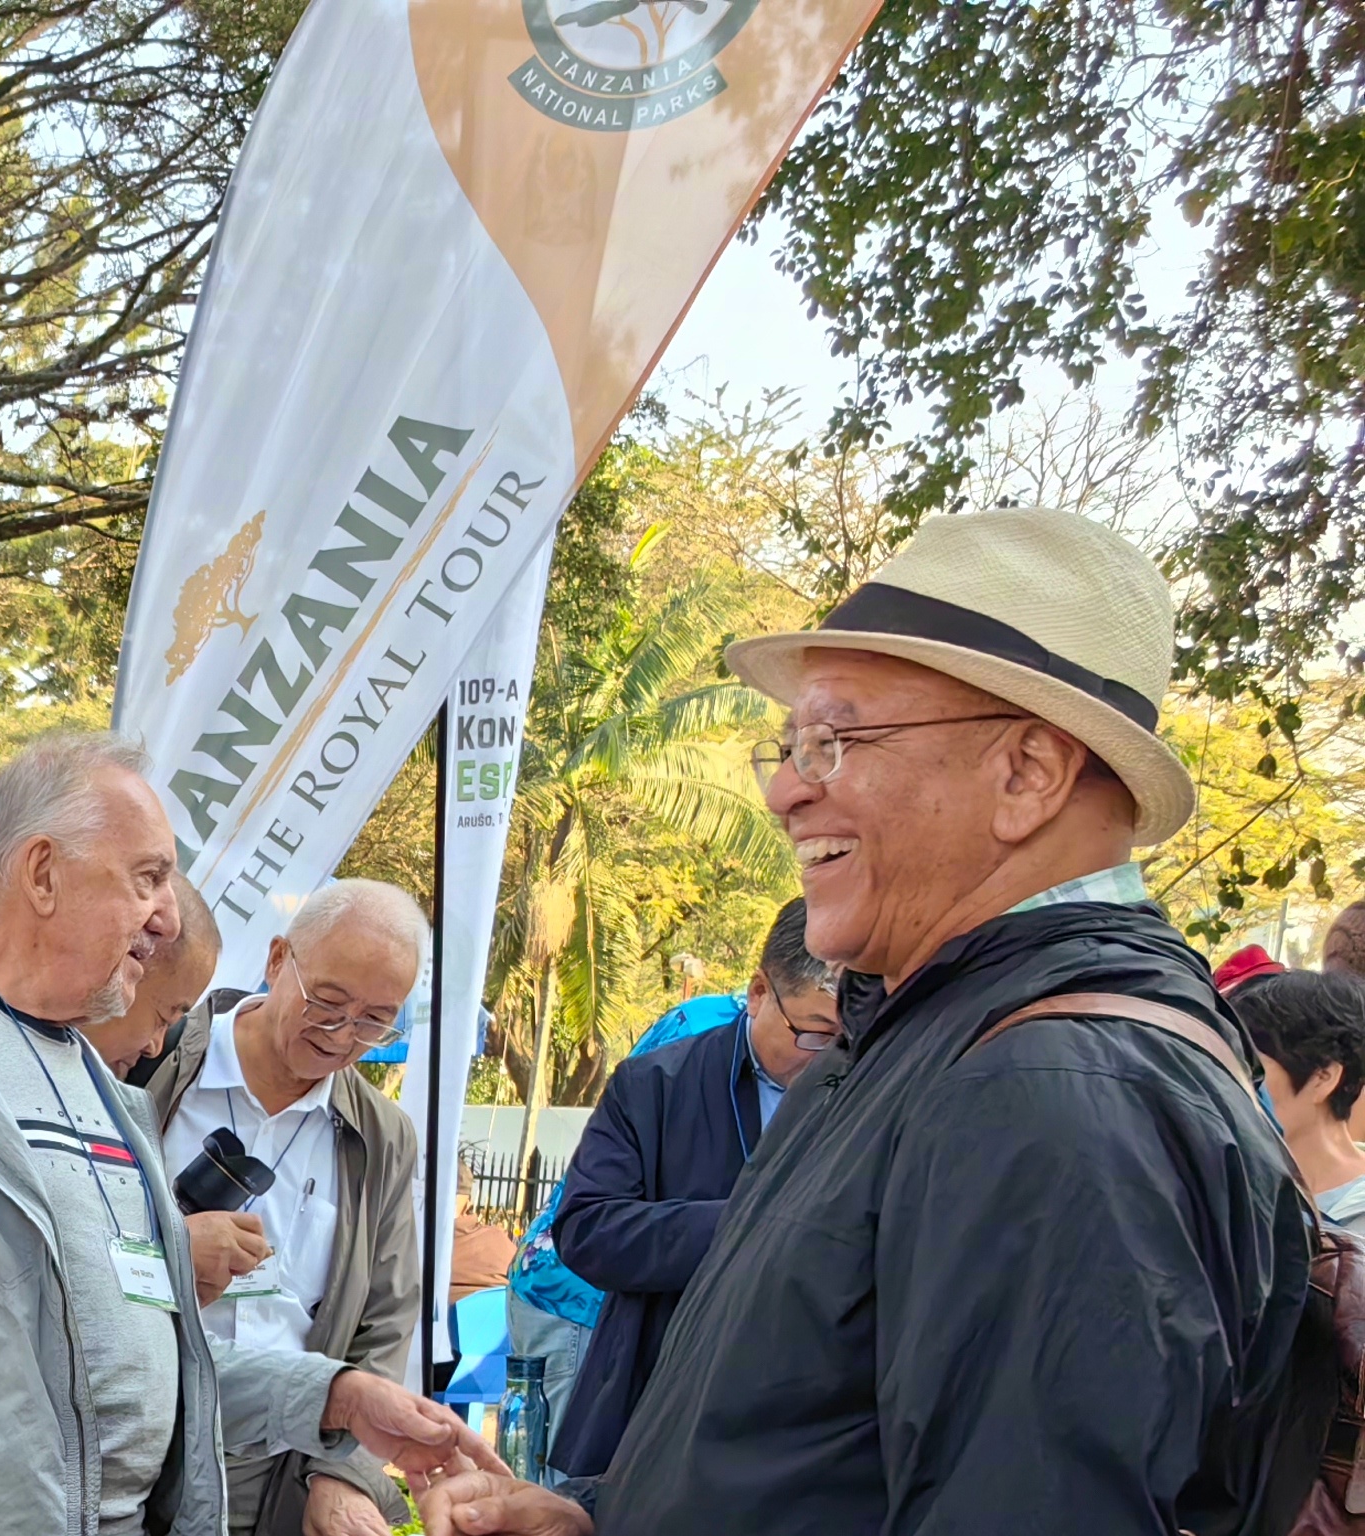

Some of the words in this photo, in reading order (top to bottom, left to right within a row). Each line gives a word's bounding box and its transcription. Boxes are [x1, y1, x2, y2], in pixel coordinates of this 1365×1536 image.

[521, 67, 623, 126] NATIONAL
[636, 74, 718, 123] PARKS
[554, 51, 693, 93] TANZANIA
[213, 819, 304, 925] THE
[290, 644, 427, 816] ROYAL
[404, 470, 548, 627] TOUR
[459, 679, 518, 706] 109-A
